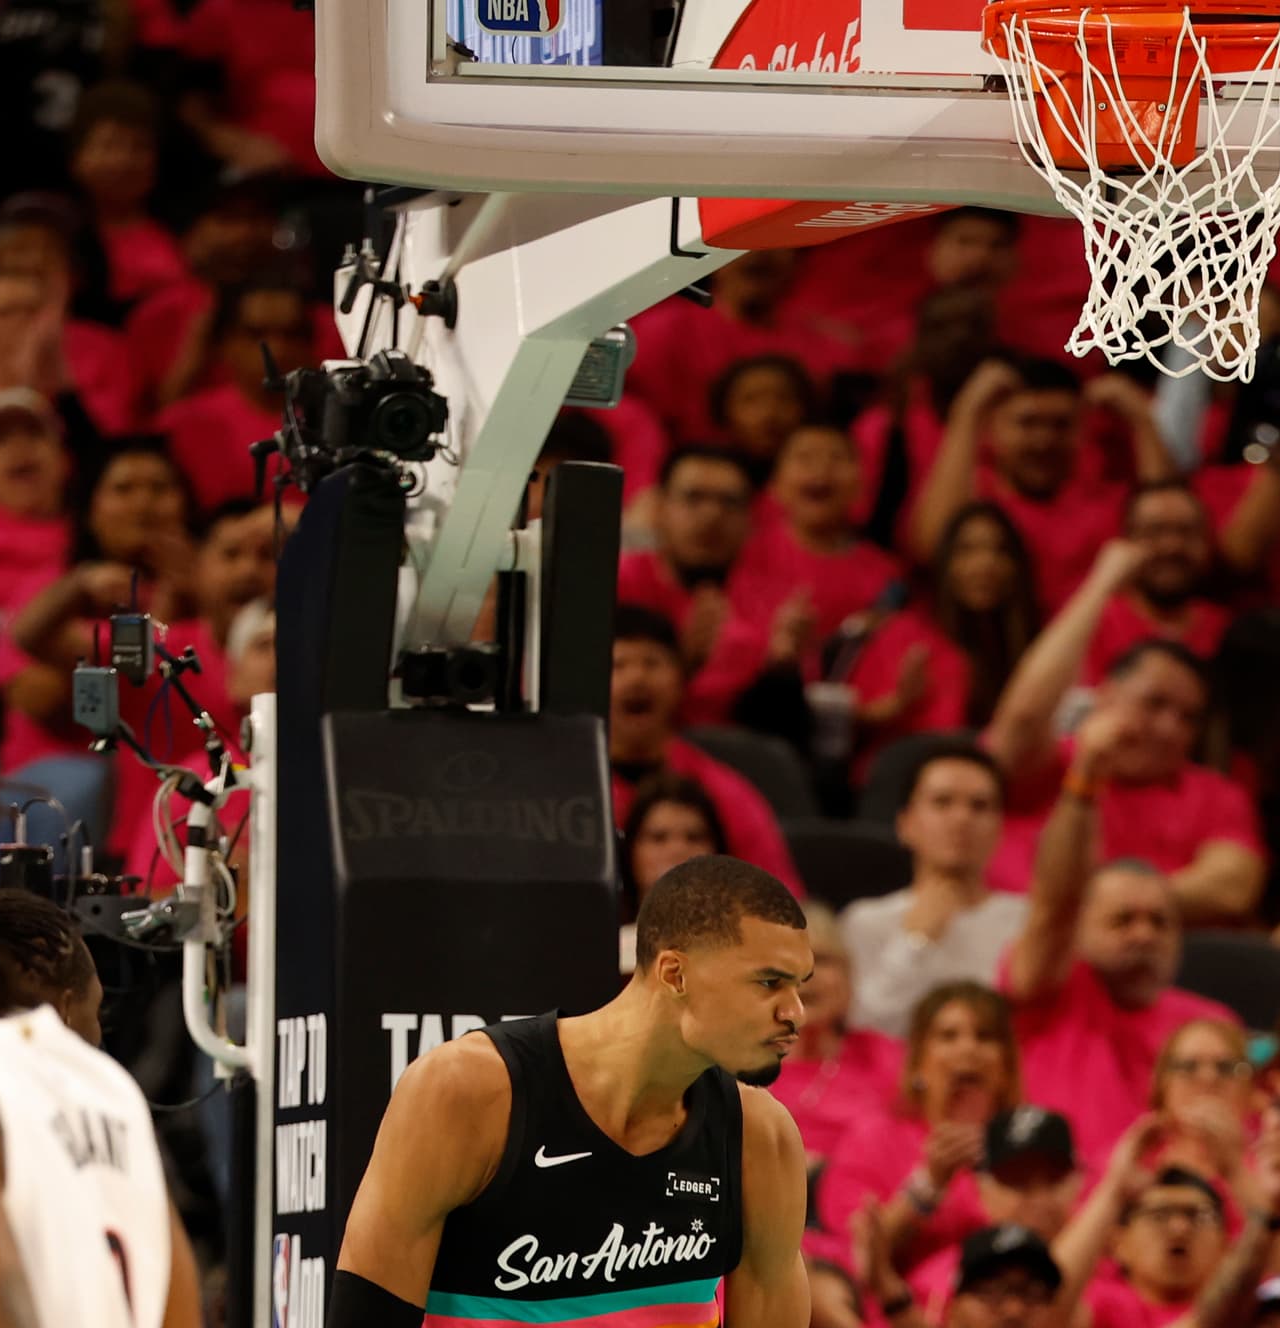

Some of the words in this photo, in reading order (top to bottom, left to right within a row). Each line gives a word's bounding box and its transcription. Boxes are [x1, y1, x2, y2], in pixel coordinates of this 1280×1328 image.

[487, 0, 529, 21] NBA
[345, 789, 597, 847] SPALDING
[277, 1016, 307, 1109] TAP
[307, 1013, 327, 1106] TO
[276, 1119, 327, 1215] WATCH
[672, 1179, 712, 1195] LEDGER
[494, 1234, 579, 1291] San
[582, 1218, 716, 1282] Antonio
